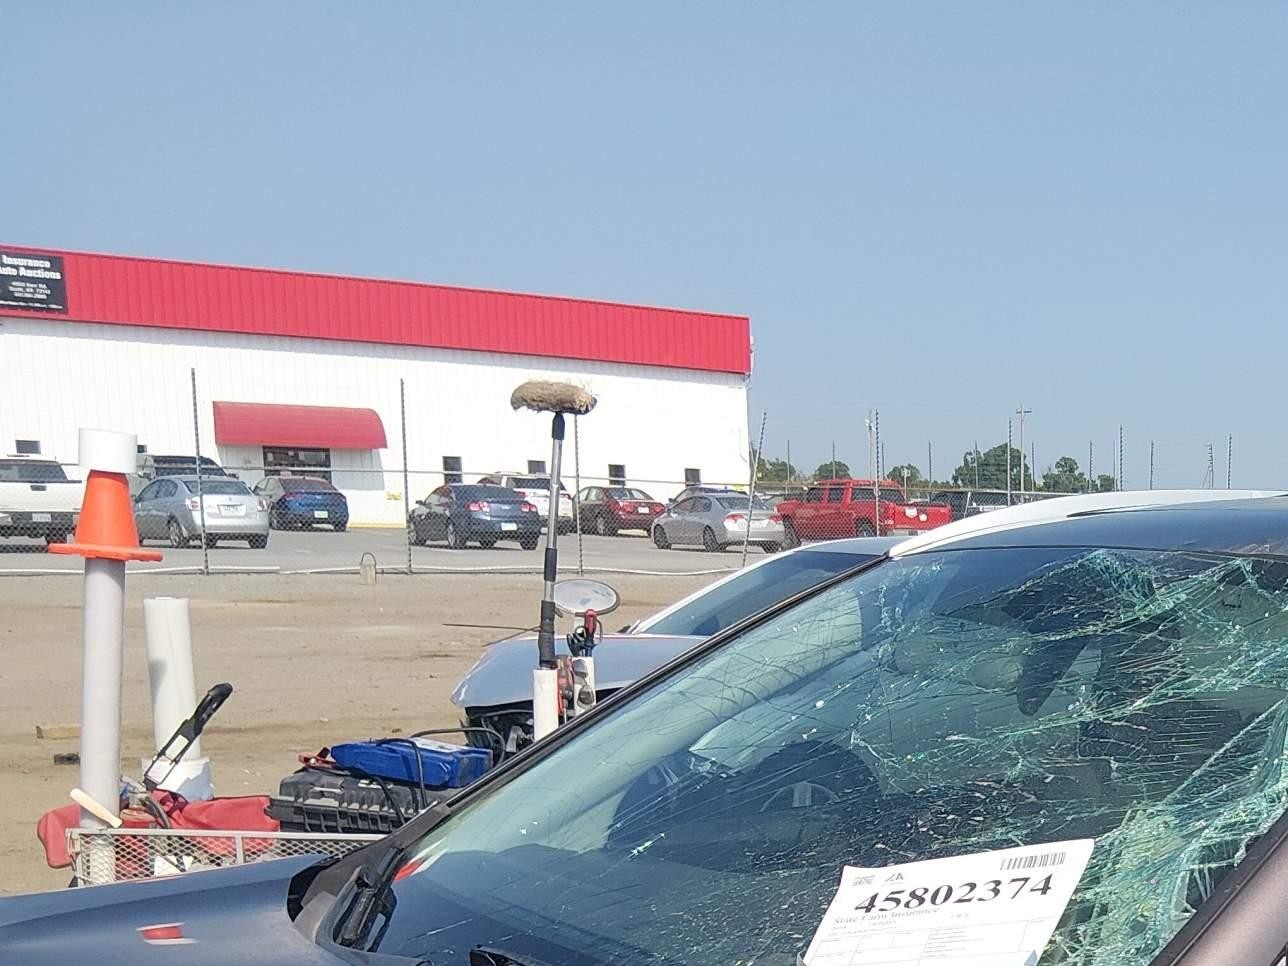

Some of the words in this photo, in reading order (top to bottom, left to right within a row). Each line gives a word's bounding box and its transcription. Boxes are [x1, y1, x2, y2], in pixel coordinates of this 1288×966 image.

[1, 255, 51, 268] Insurance
[19, 266, 61, 279] Auctions
[854, 873, 1053, 913] 45802374
